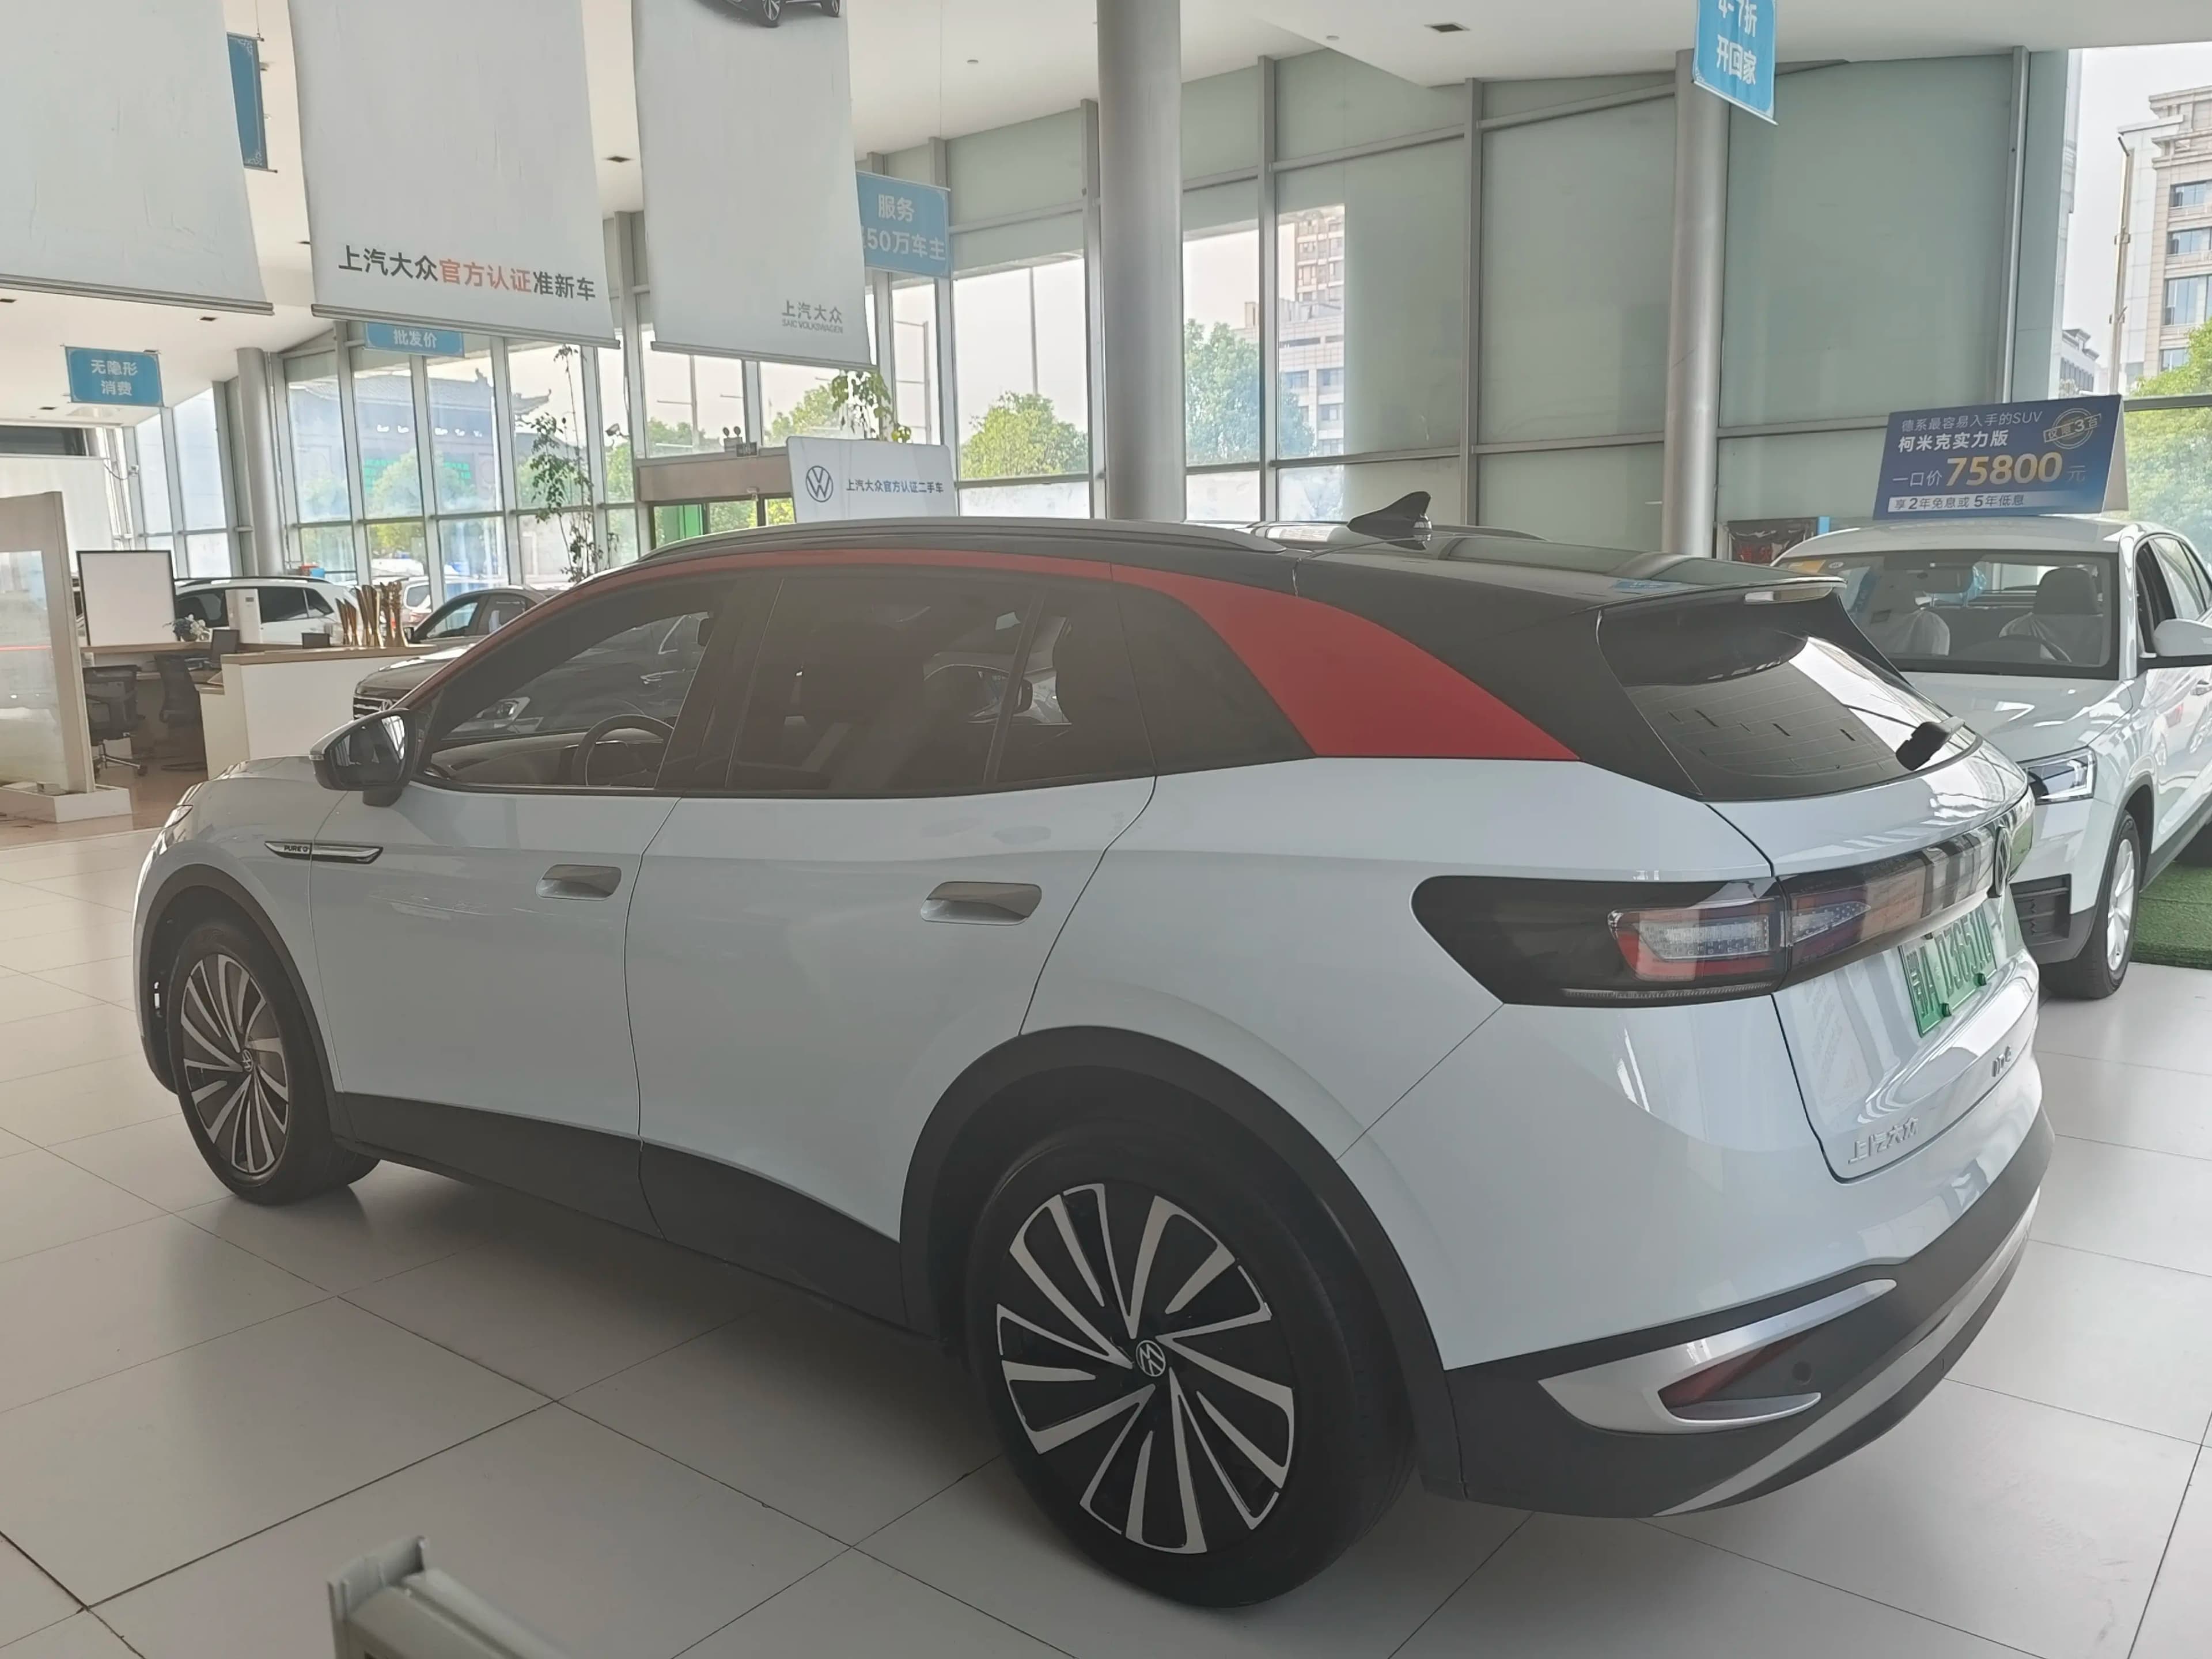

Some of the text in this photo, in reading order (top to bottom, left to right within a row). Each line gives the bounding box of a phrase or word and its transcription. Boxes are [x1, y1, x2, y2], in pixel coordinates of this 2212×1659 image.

[1717, 34, 1756, 85] 开回家
[878, 194, 915, 222] 服务
[862, 225, 945, 261] 50万车主
[339, 245, 596, 301] 上汽大众官方认证准新车
[782, 300, 842, 324] 上汽大众
[393, 329, 437, 349] 批发价
[90, 359, 138, 376] 无隐形
[101, 380, 132, 396] 消费
[1902, 411, 2043, 432] 德系最容易入手的SUV
[1898, 430, 2009, 453] 柯米克实力版
[846, 479, 944, 494] 上汽大众官方认证二手车
